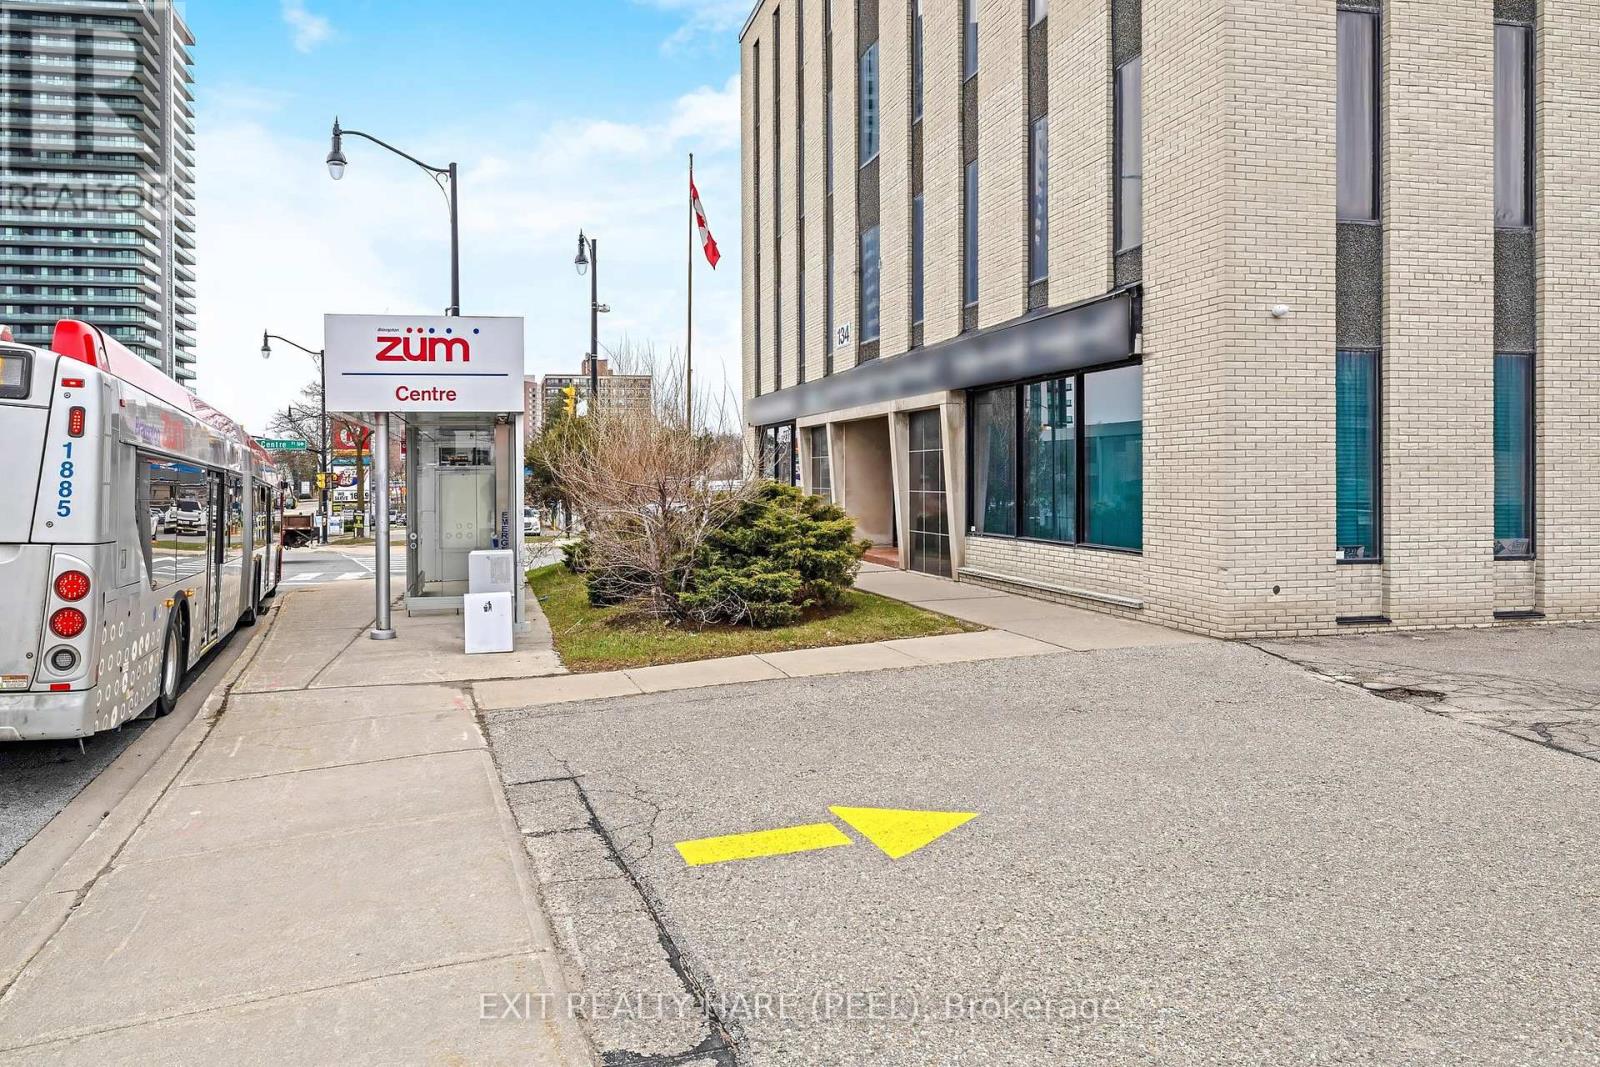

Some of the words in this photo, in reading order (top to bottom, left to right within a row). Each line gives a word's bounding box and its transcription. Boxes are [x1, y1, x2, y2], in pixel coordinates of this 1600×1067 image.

[837, 324, 850, 346] 134
[395, 385, 457, 401] Centre
[261, 440, 287, 448] Centre
[57, 442, 74, 517] 1885
